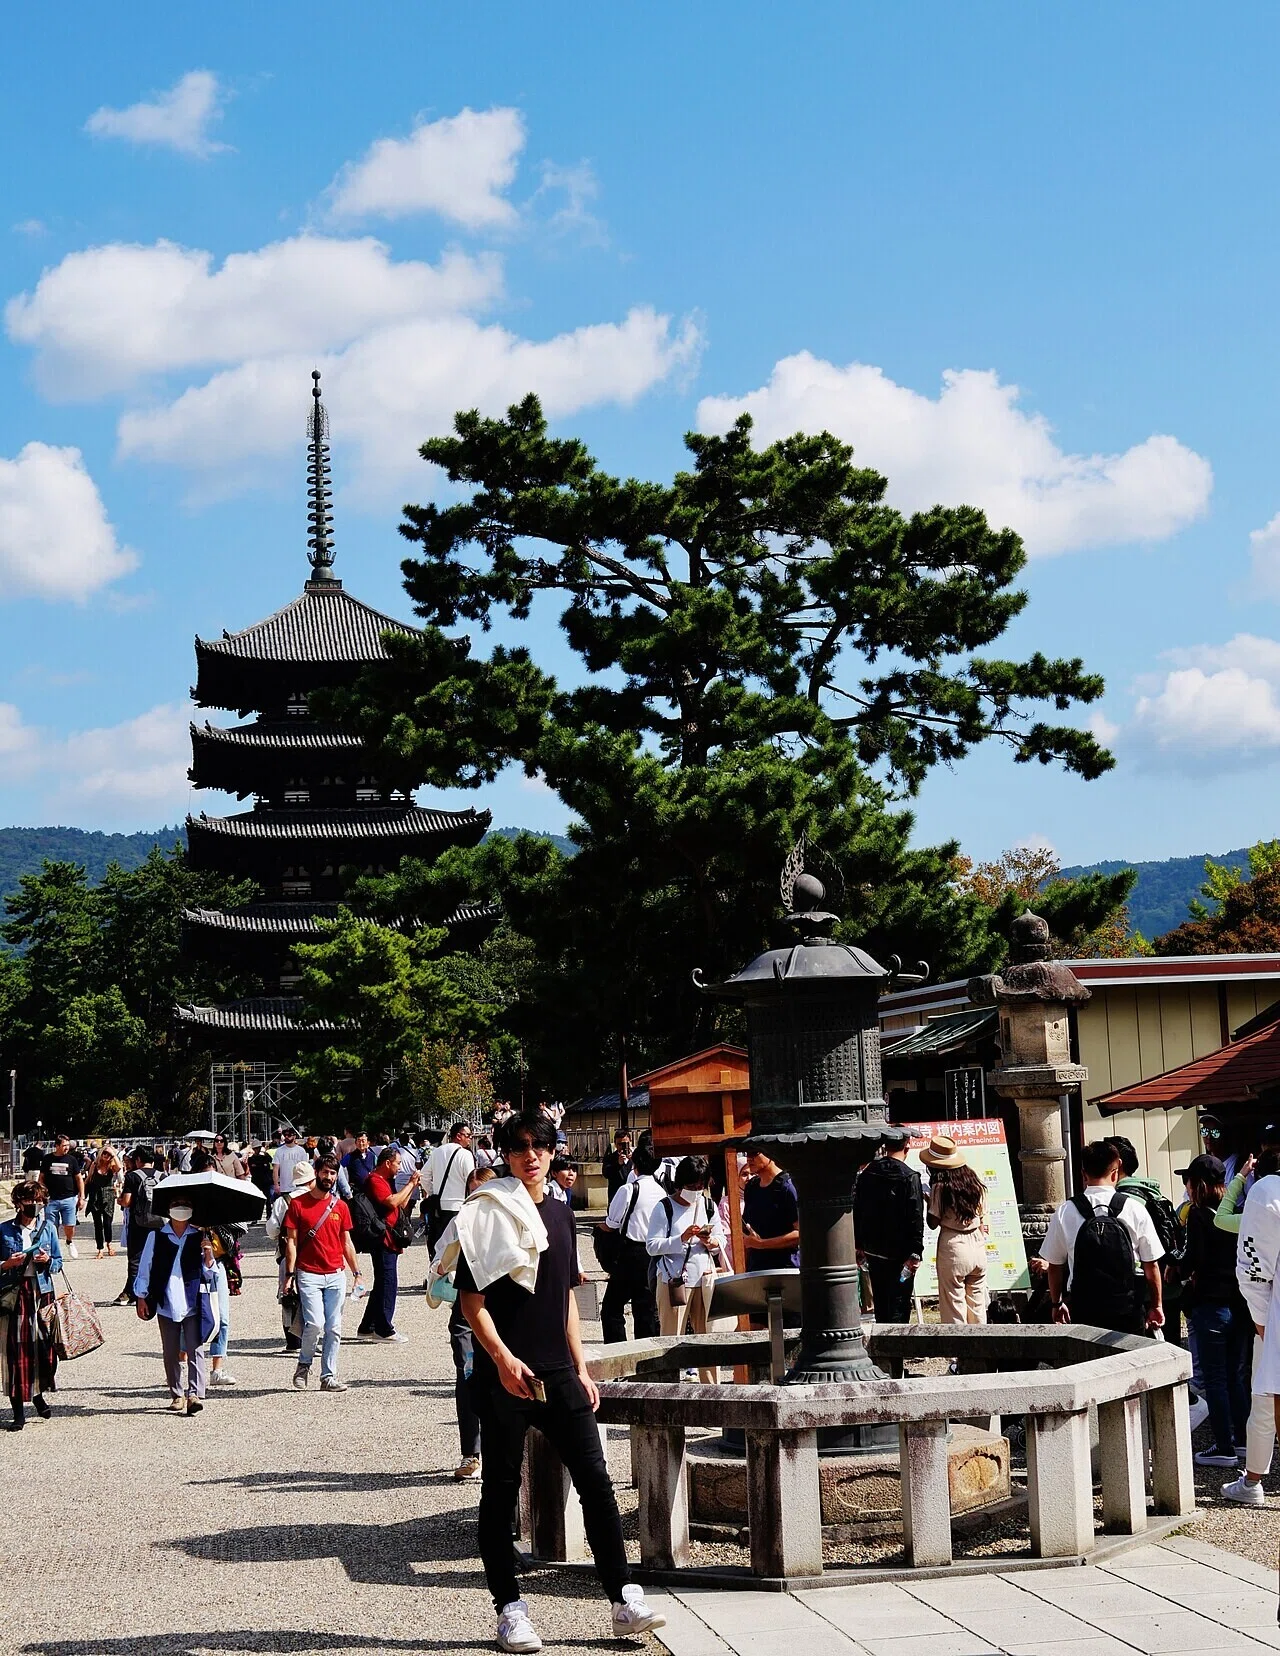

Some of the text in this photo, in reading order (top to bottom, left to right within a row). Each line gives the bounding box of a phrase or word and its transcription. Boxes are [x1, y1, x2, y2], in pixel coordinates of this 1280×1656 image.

[936, 1121, 1000, 1137] 境内案内図
